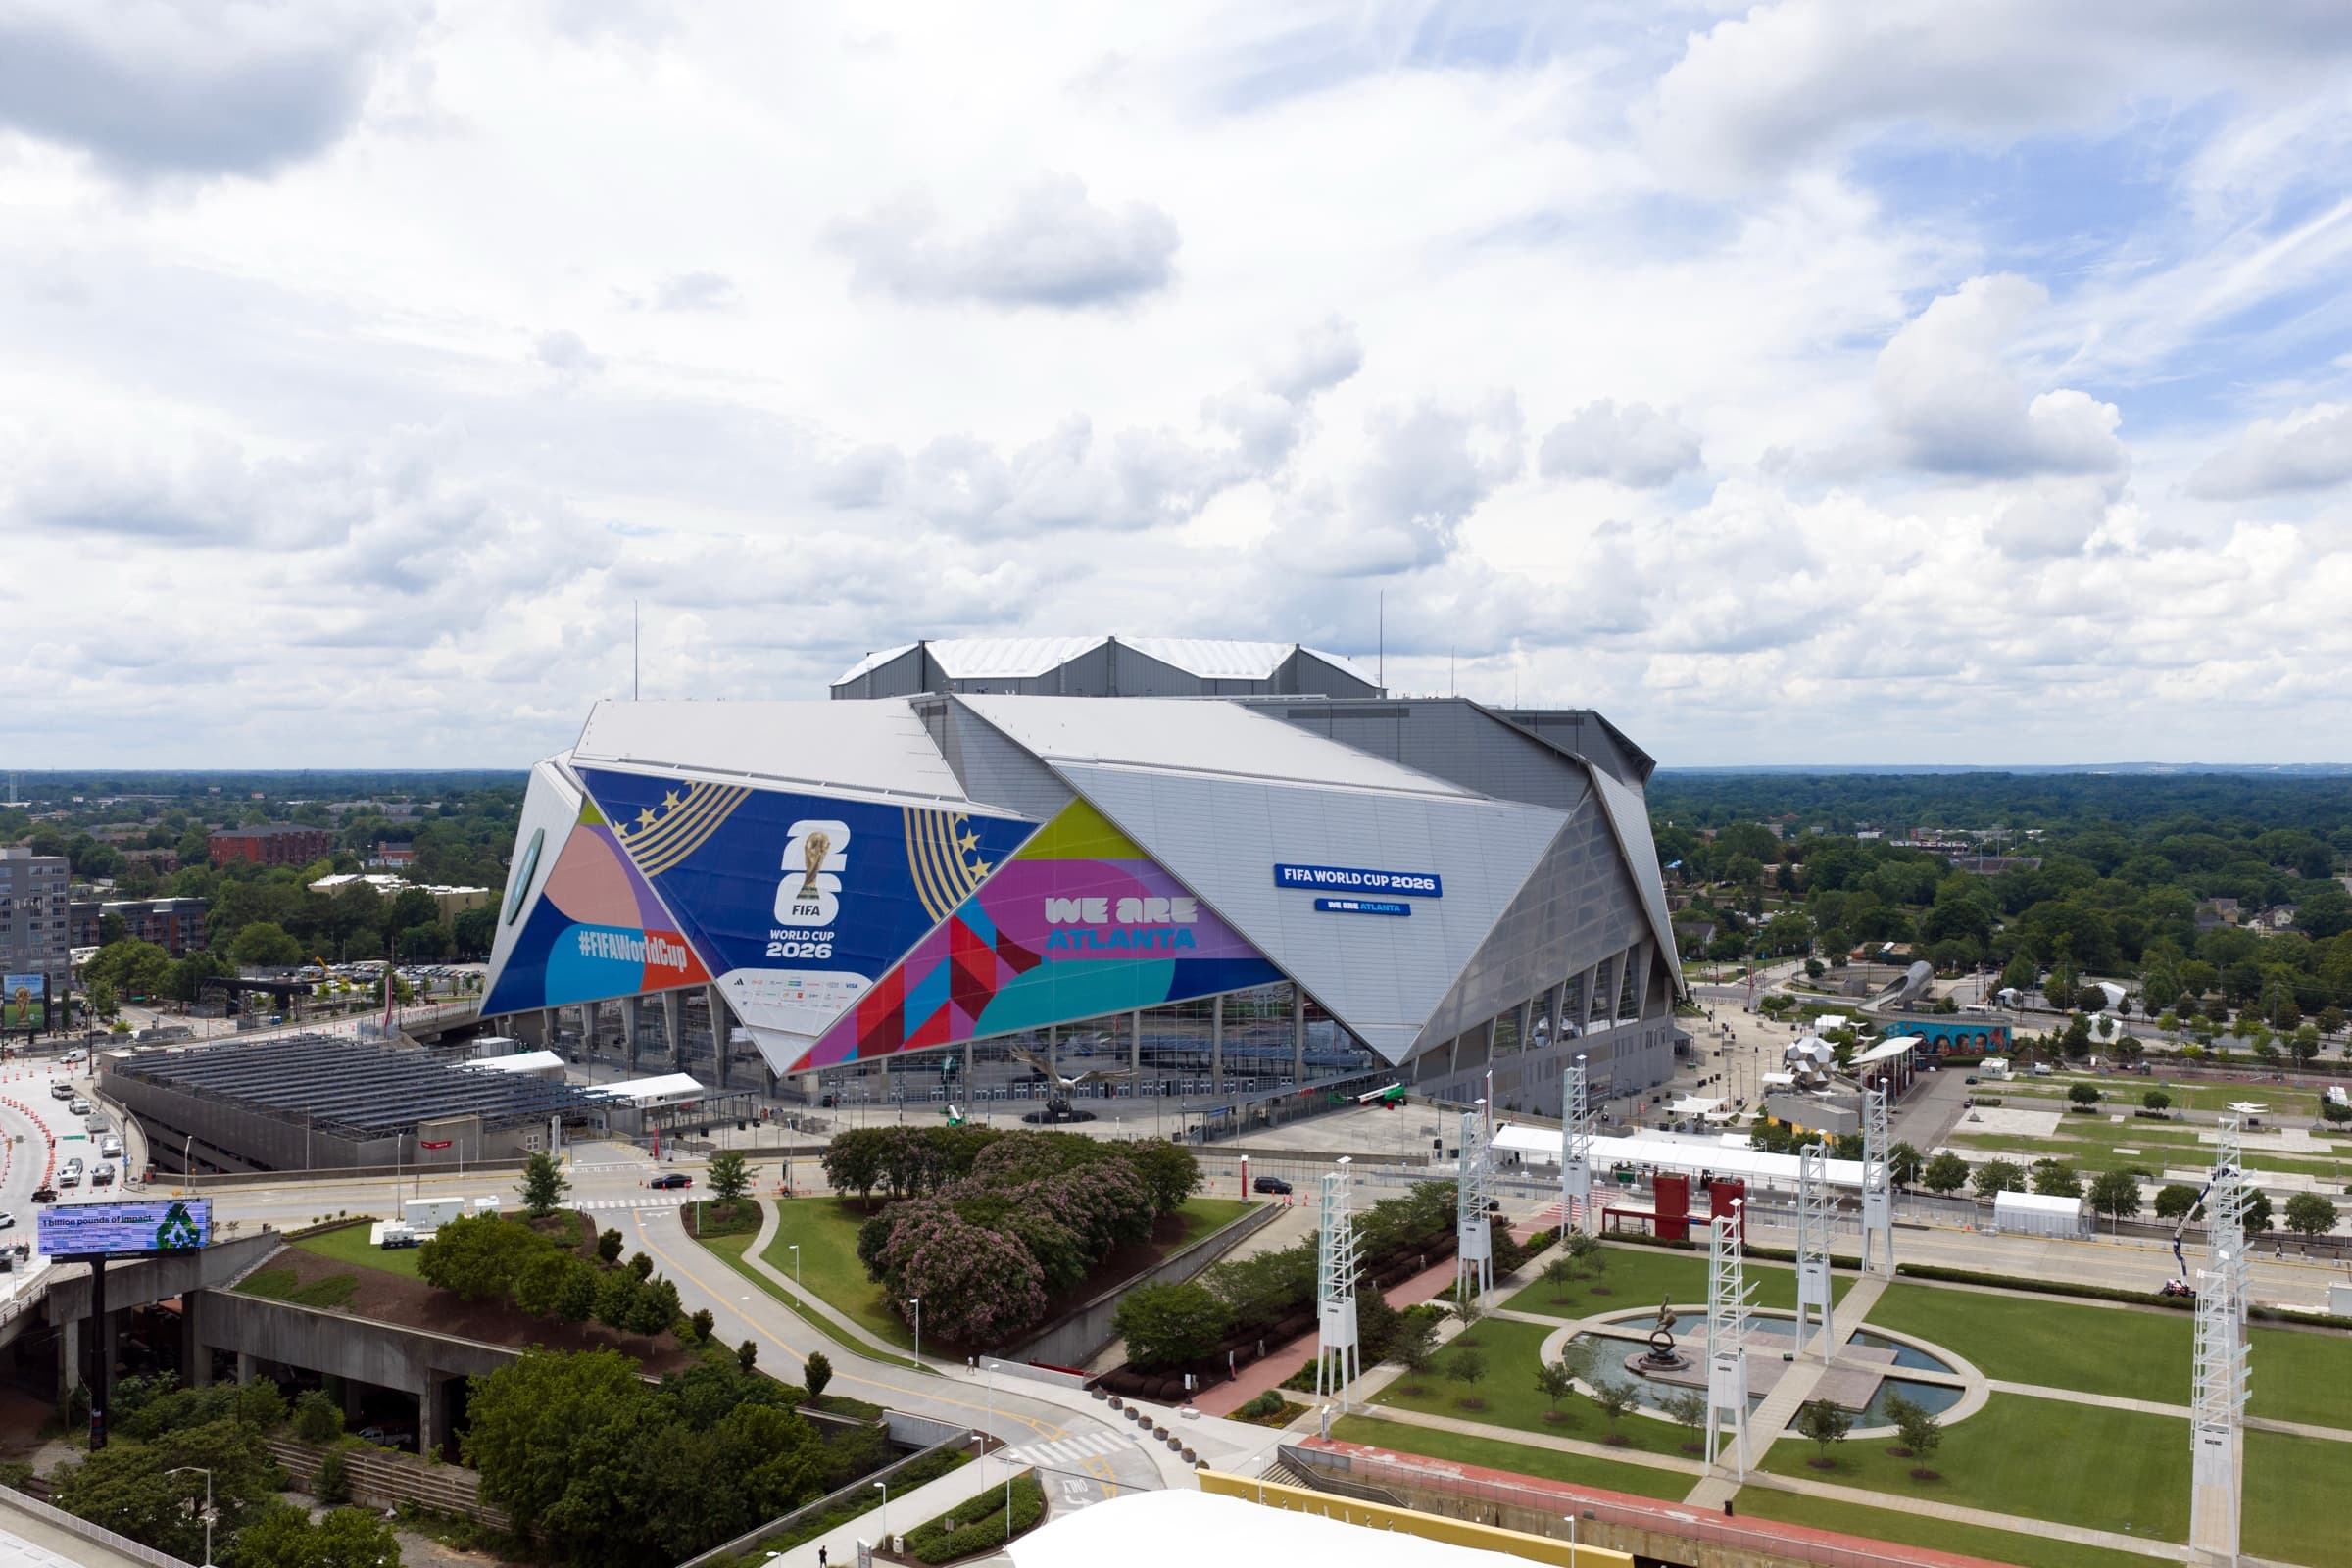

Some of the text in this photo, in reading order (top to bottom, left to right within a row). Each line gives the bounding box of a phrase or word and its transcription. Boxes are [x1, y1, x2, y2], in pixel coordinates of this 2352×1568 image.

[1284, 868, 1436, 890] FIFA WORLD CUP 2026
[792, 905, 820, 916] FIFA
[1045, 897, 1109, 924] WE
[1328, 901, 1342, 909] WE
[1360, 903, 1401, 912] ATLANTA
[769, 930, 835, 942] WORLD CUP
[1046, 928, 1196, 949] ATLANTA
[578, 930, 687, 972] #FIFAWorldCup
[766, 942, 832, 959] 2026
[77, 1216, 110, 1226] pounds
[122, 1214, 155, 1224] impact.
[1063, 1479, 1088, 1494] ONLY
